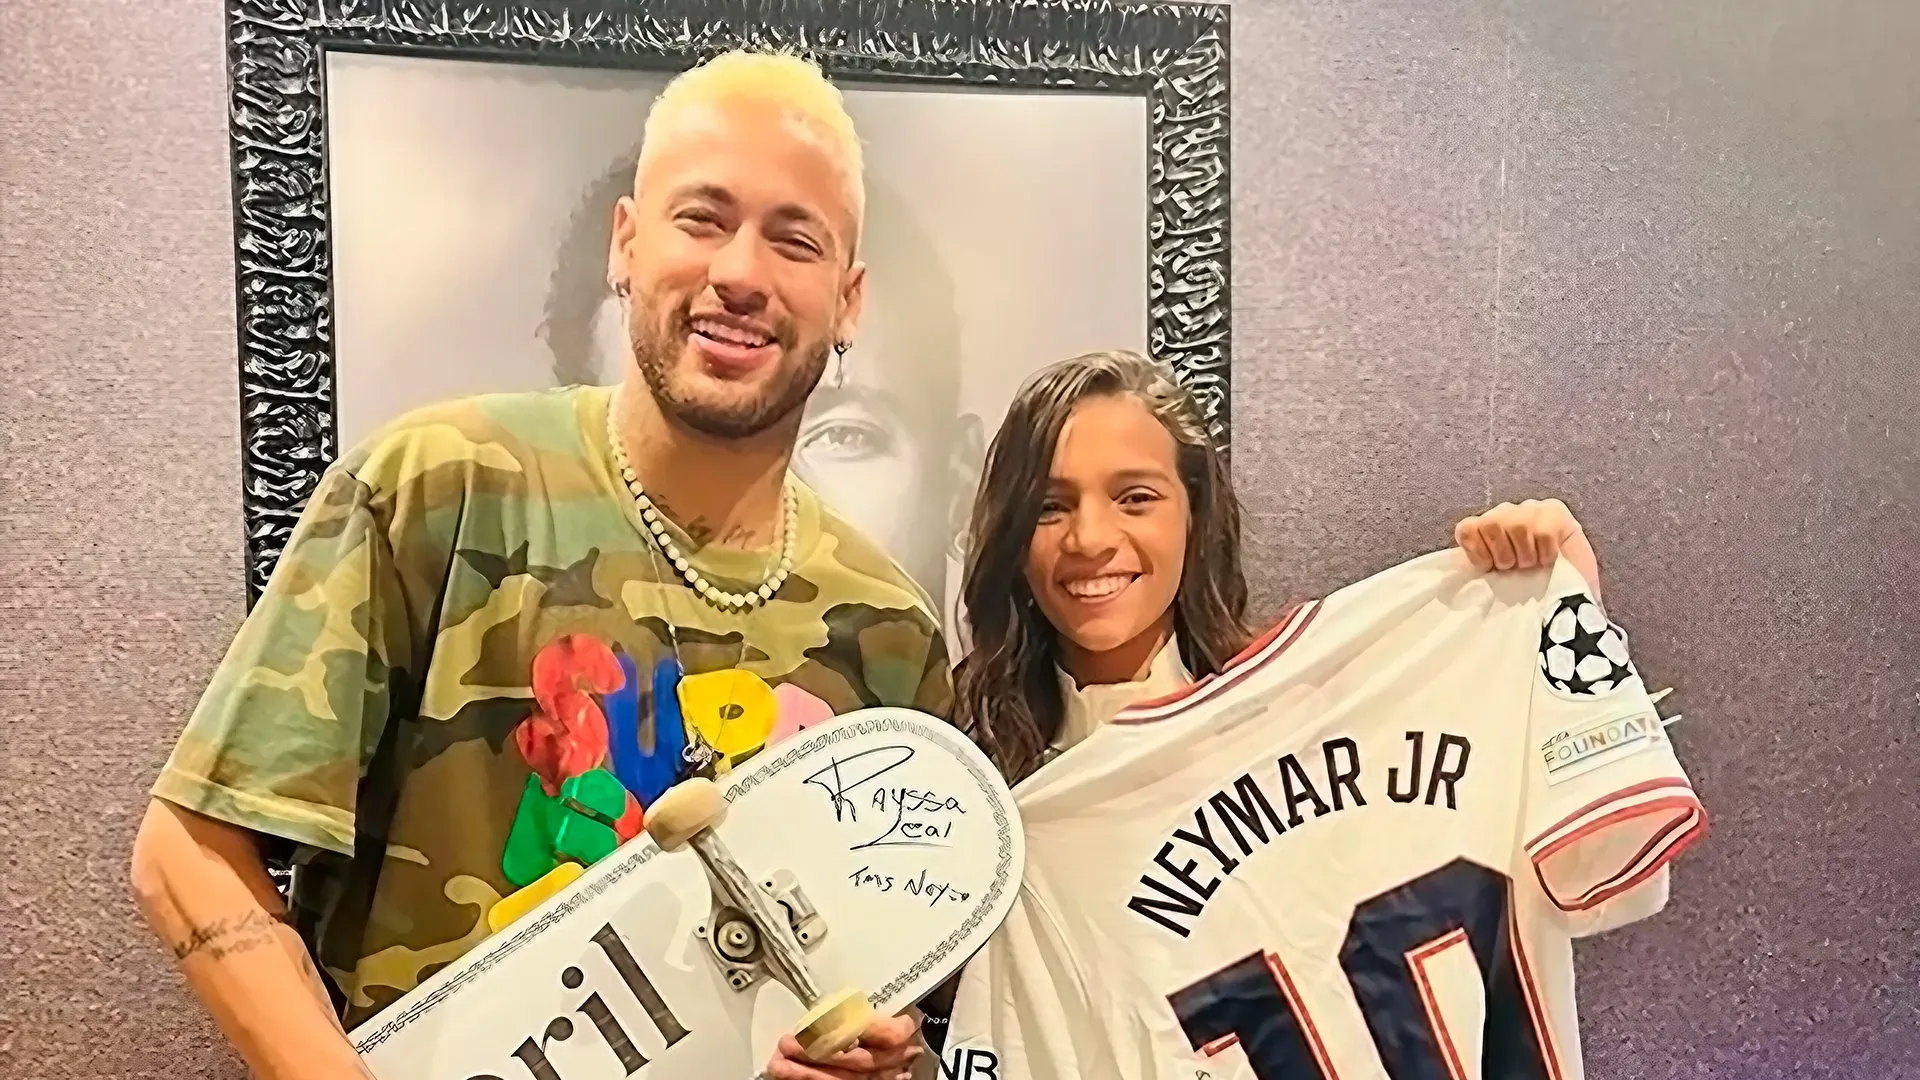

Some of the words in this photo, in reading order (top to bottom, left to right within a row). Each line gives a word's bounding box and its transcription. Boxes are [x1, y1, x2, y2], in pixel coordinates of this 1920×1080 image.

[1127, 736, 1368, 938] NEYMAR
[1387, 731, 1471, 810] JR
[466, 922, 692, 1080] ril
[1166, 855, 1558, 1080] 10
